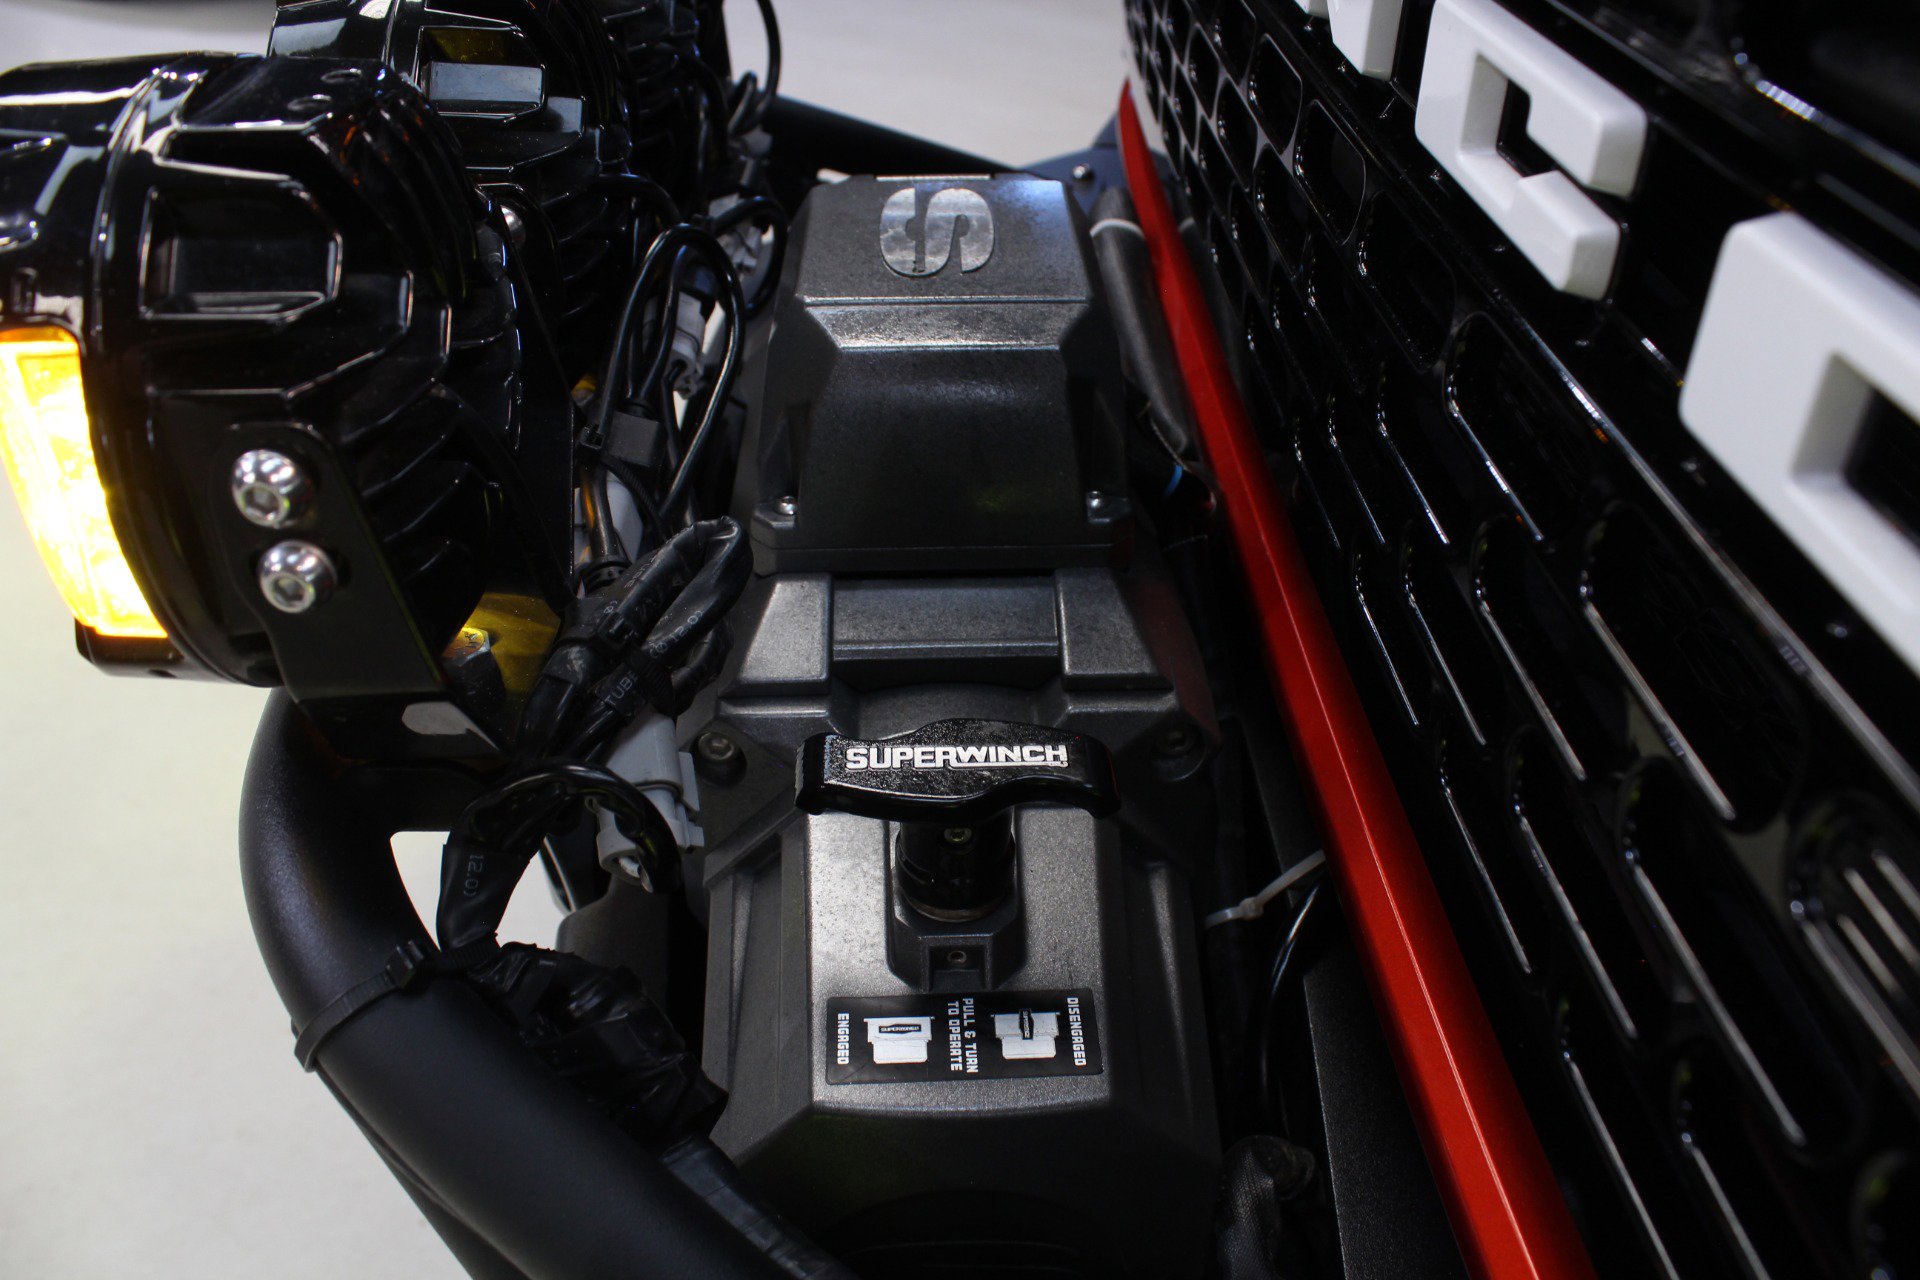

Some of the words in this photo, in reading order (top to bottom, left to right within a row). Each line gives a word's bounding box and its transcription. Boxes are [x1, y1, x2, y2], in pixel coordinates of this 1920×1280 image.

[845, 745, 1069, 768] SUPERWINCH
[948, 1001, 959, 1015] TO
[963, 997, 976, 1026] PULL
[837, 1012, 850, 1065] ENGAGED
[948, 1018, 963, 1071] OPERATE
[964, 1029, 977, 1038] &
[1067, 997, 1087, 1066] DISENGAGED
[965, 1042, 979, 1073] TURN
